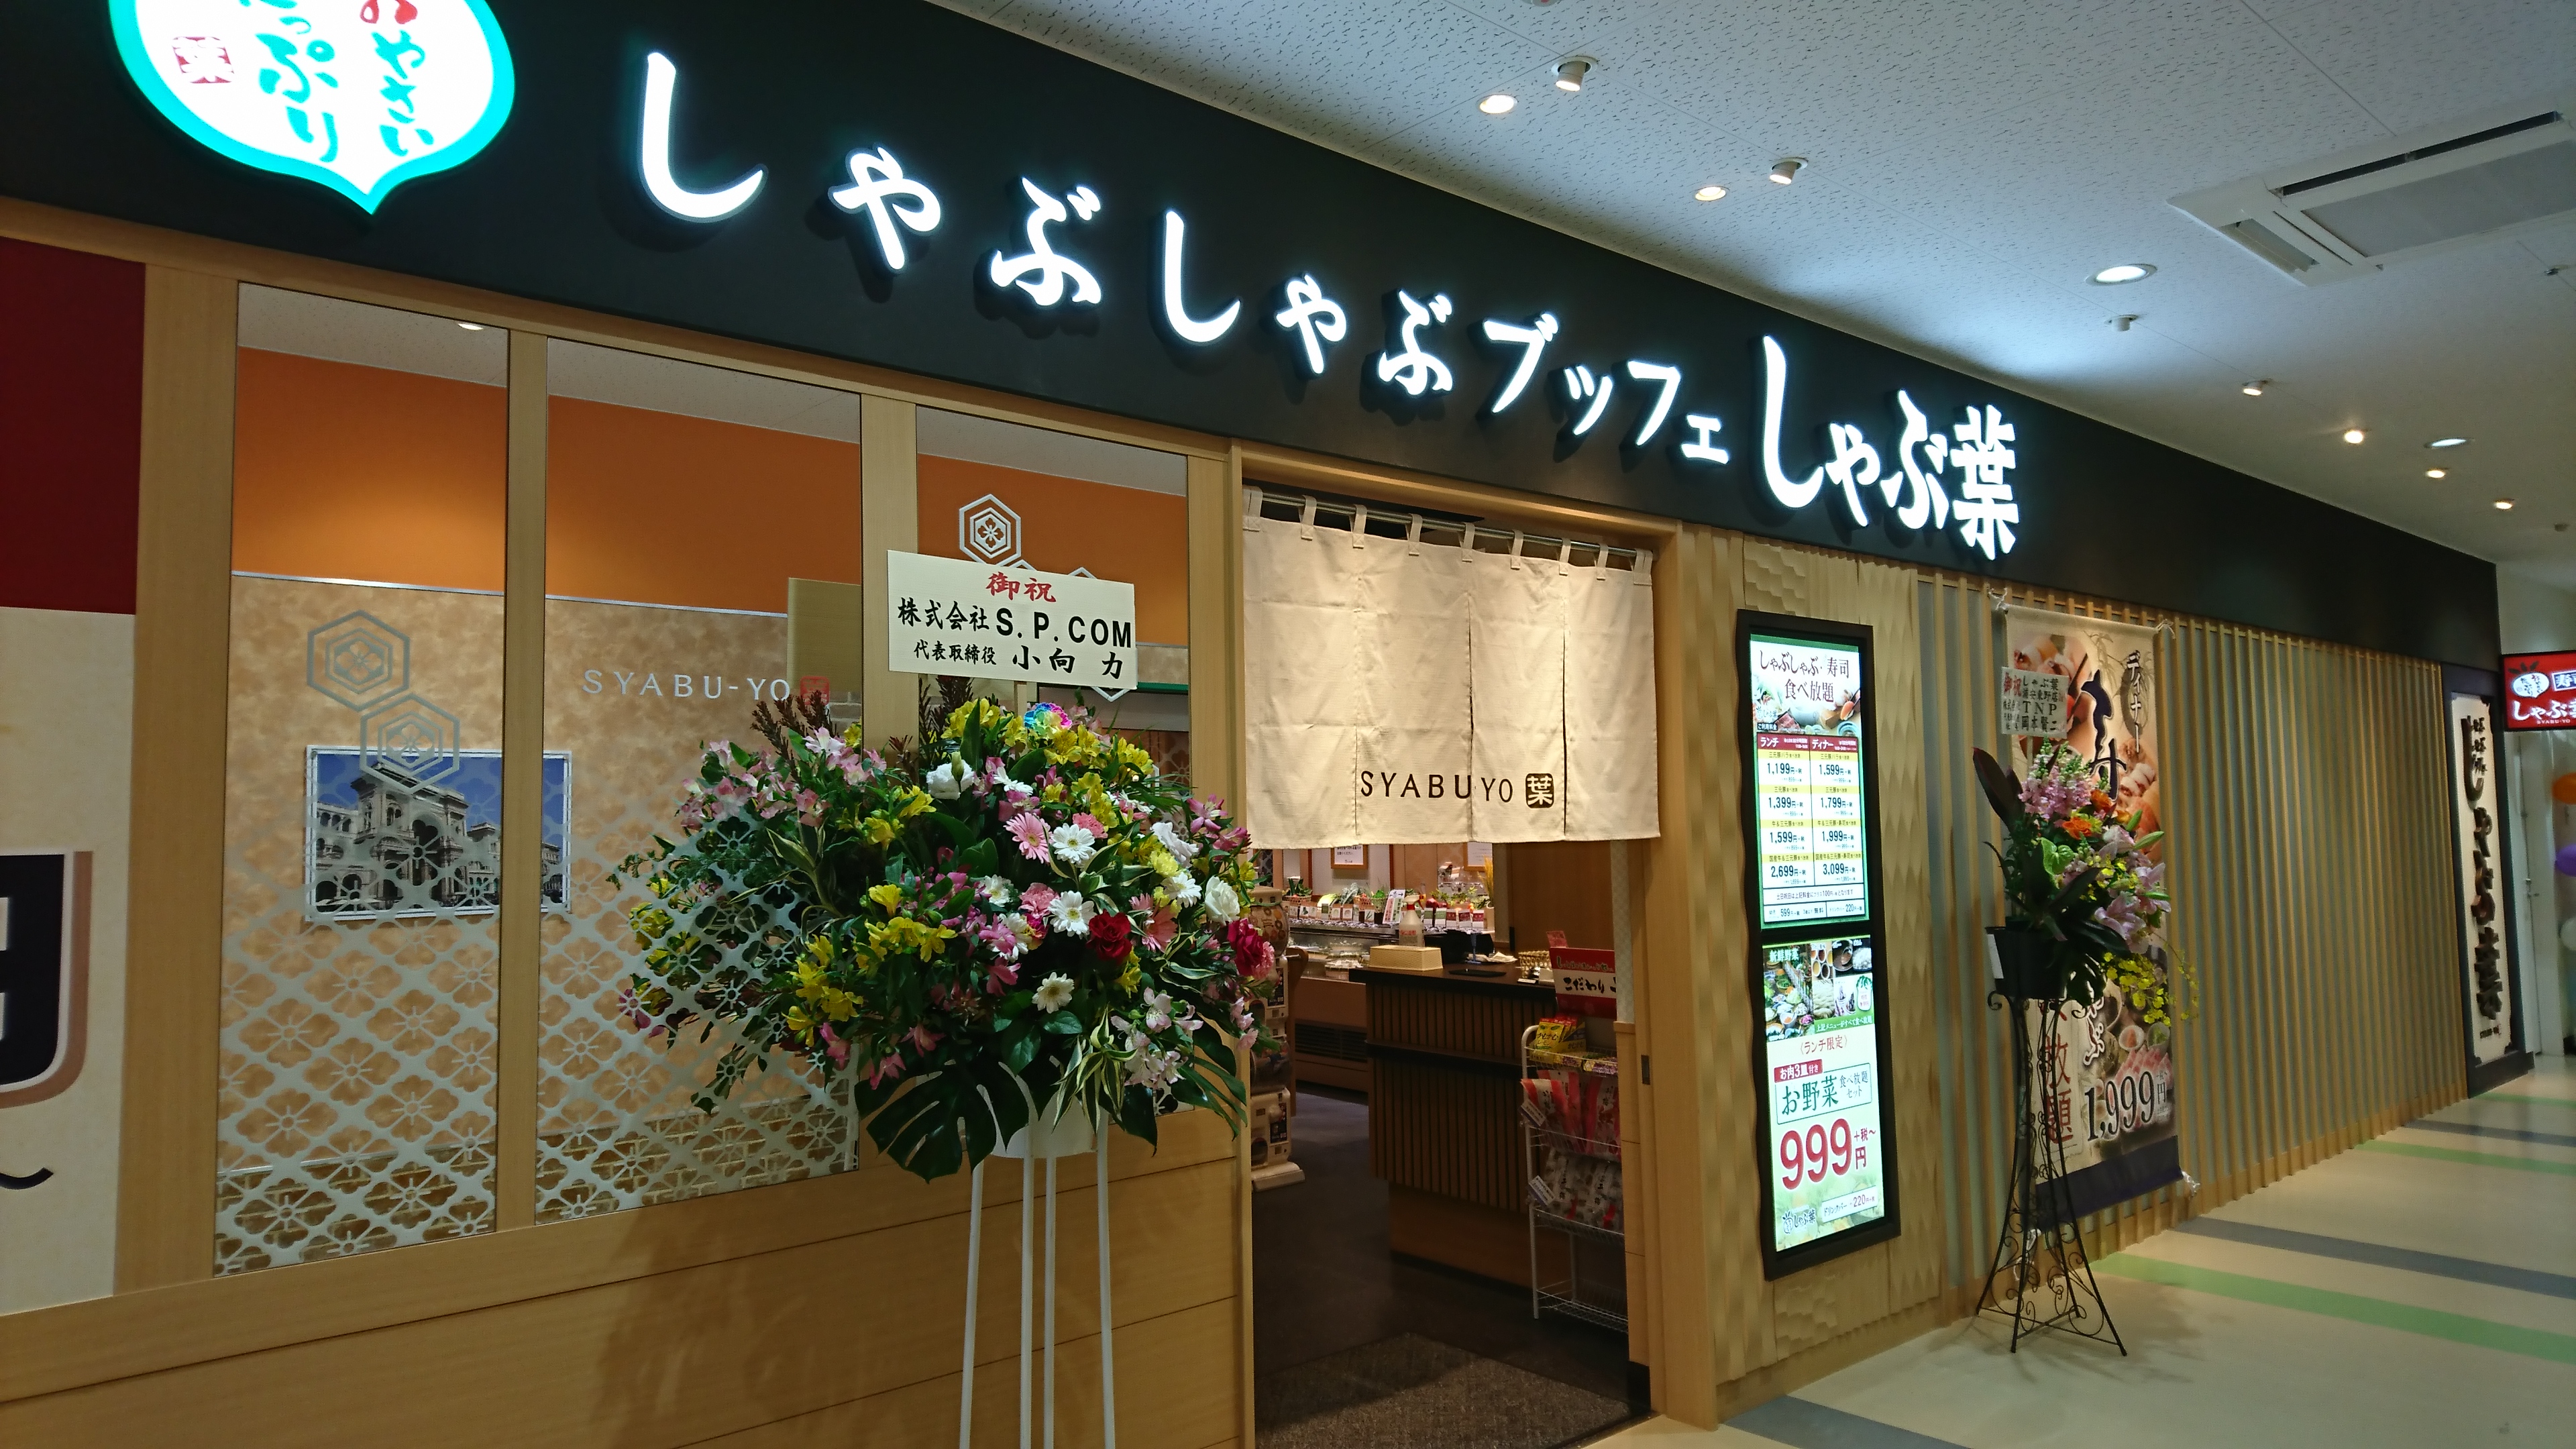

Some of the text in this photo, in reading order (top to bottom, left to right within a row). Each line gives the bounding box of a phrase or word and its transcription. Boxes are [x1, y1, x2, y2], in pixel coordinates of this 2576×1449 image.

[238, 0, 339, 163] っぷり
[1762, 333, 2022, 561] しゃぶ葉
[985, 571, 1057, 602] 御祝
[913, 639, 998, 665] 代表取締役
[1101, 651, 1124, 680] 力
[582, 669, 791, 701] SYABU-YO
[1784, 678, 1834, 703] 食べ放題
[2023, 676, 2059, 691] しゃぶ葉
[2555, 674, 2576, 688] 寿
[2022, 700, 2057, 716] TNP
[2127, 649, 2141, 753] ディナー
[1760, 737, 1779, 748] ランチ
[1812, 739, 1834, 750] ディナー
[1360, 770, 1513, 803] SYABUYO
[1525, 773, 1555, 809] 葉
[1769, 948, 1800, 963] 新鮮野菜
[1780, 1063, 1819, 1081] お肉3皿付き
[1839, 1070, 1869, 1088] 食べ放題
[1782, 1075, 1839, 1116] お野菜
[1847, 1085, 1862, 1099] セット
